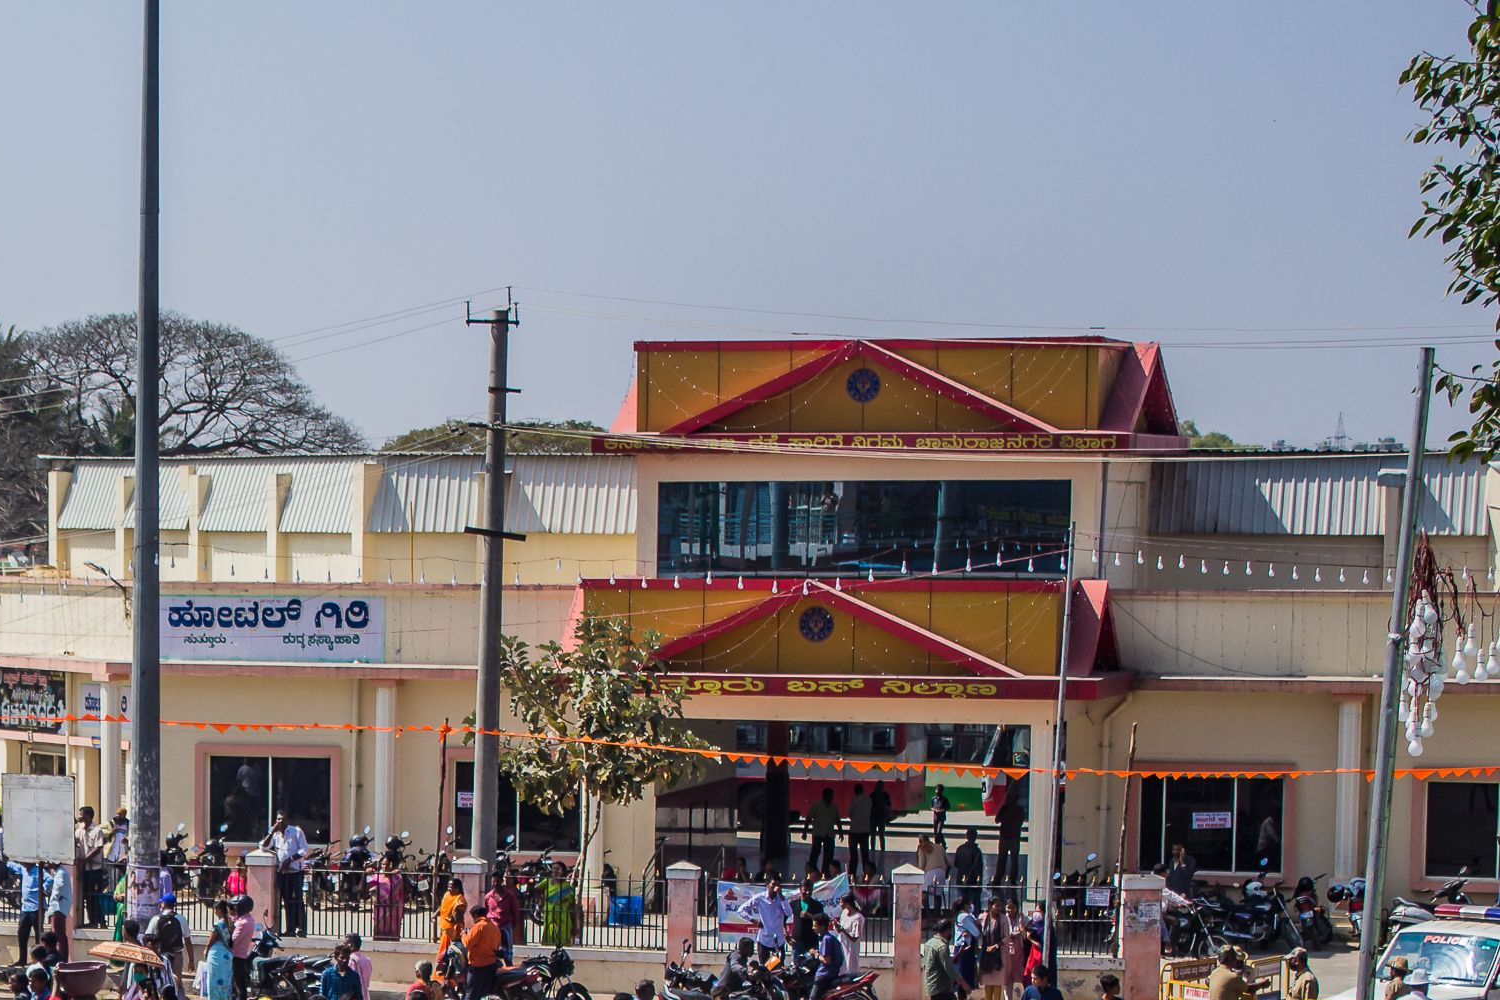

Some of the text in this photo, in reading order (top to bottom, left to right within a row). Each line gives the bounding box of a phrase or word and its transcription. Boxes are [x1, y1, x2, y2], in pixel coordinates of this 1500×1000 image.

[915, 434, 1054, 449] ಚಾಮರಾಜನಗರ
[1058, 434, 1117, 449] ವಿಭಾಗ
[314, 600, 370, 629] ಗಿರಿ
[621, 677, 998, 699] ತ್ತೂರು ಬಸ್ ನಿಲ್ದಾಣ
[1424, 934, 1468, 946] POLICE
